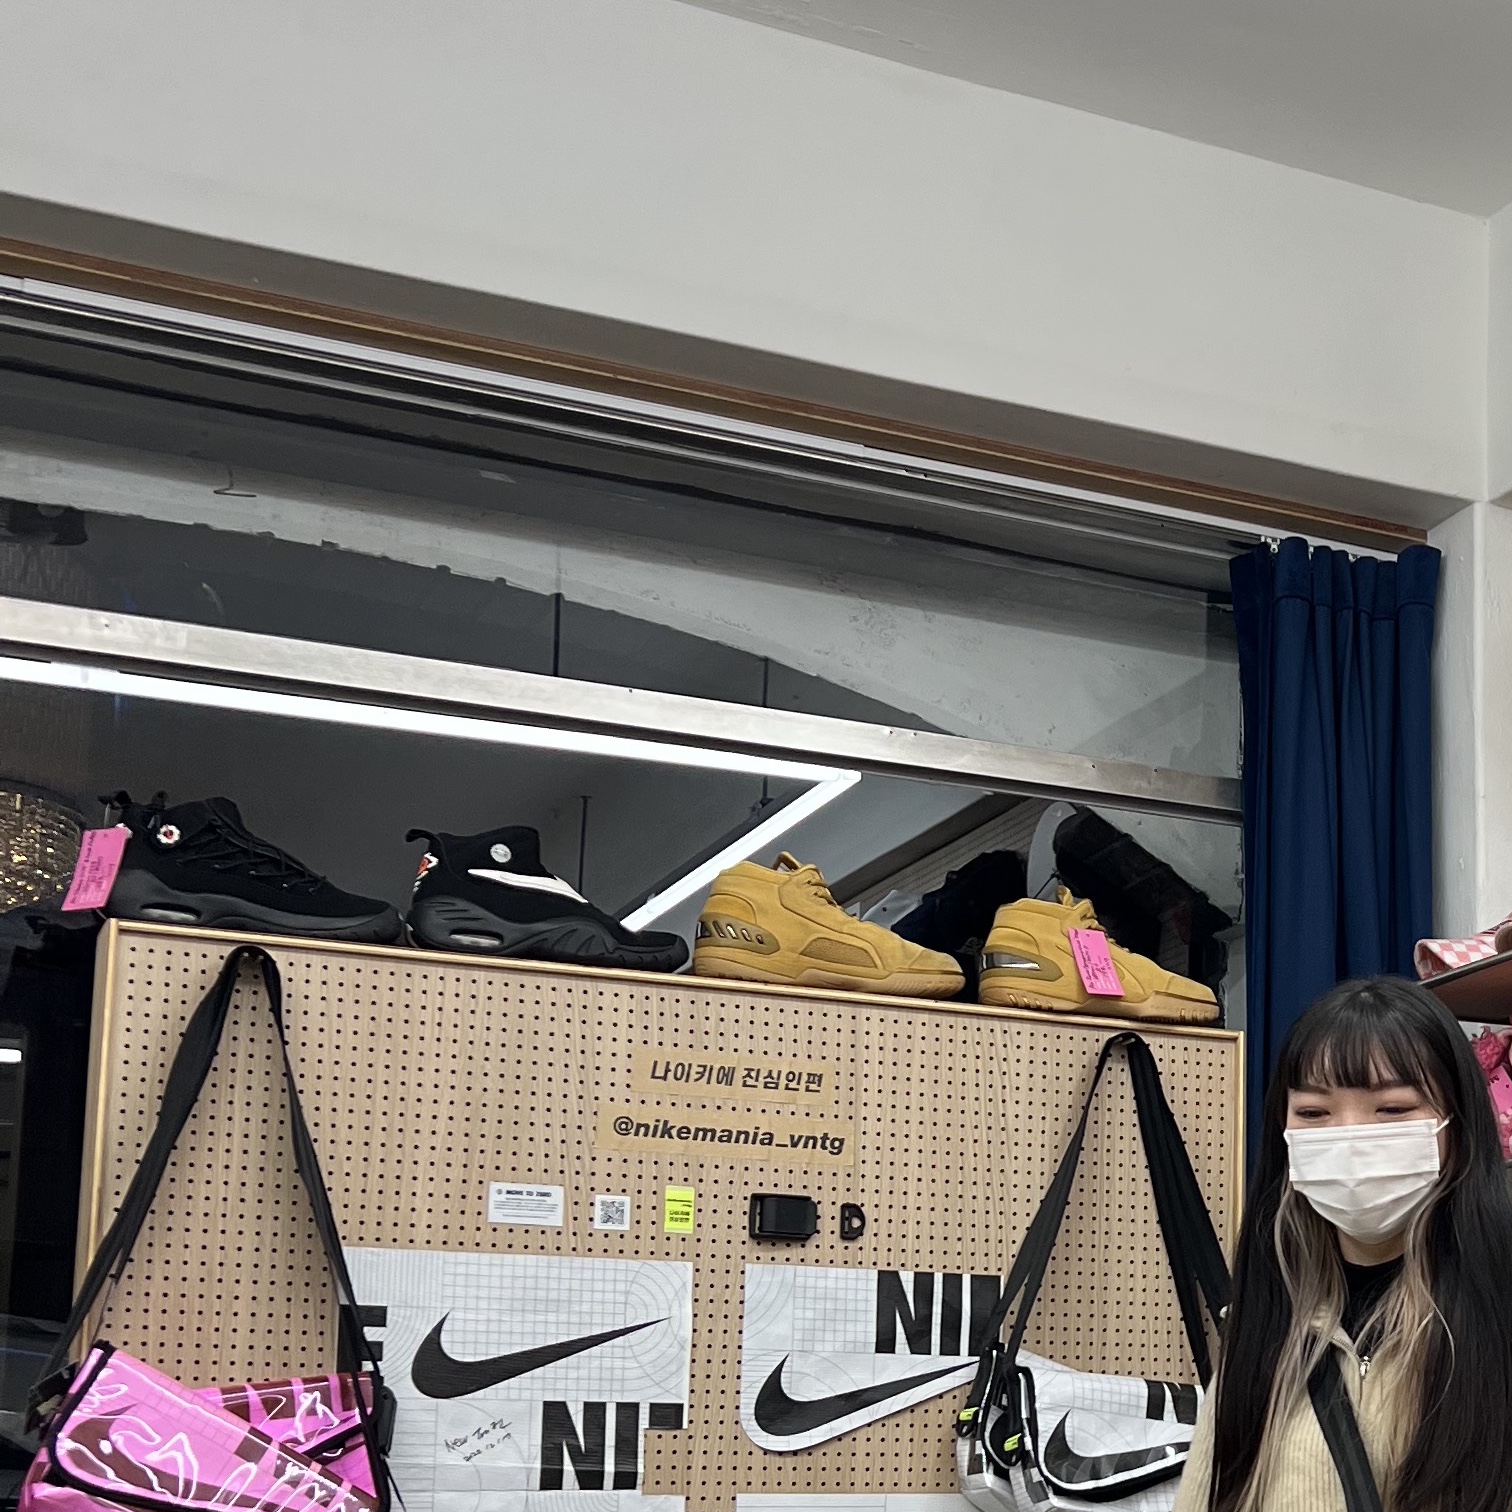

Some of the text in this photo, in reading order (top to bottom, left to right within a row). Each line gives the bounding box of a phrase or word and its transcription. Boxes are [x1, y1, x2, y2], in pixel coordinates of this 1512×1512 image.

[650, 1060, 825, 1094] 나이키에 진심인편
[612, 1115, 846, 1156] @nikemania_vntg
